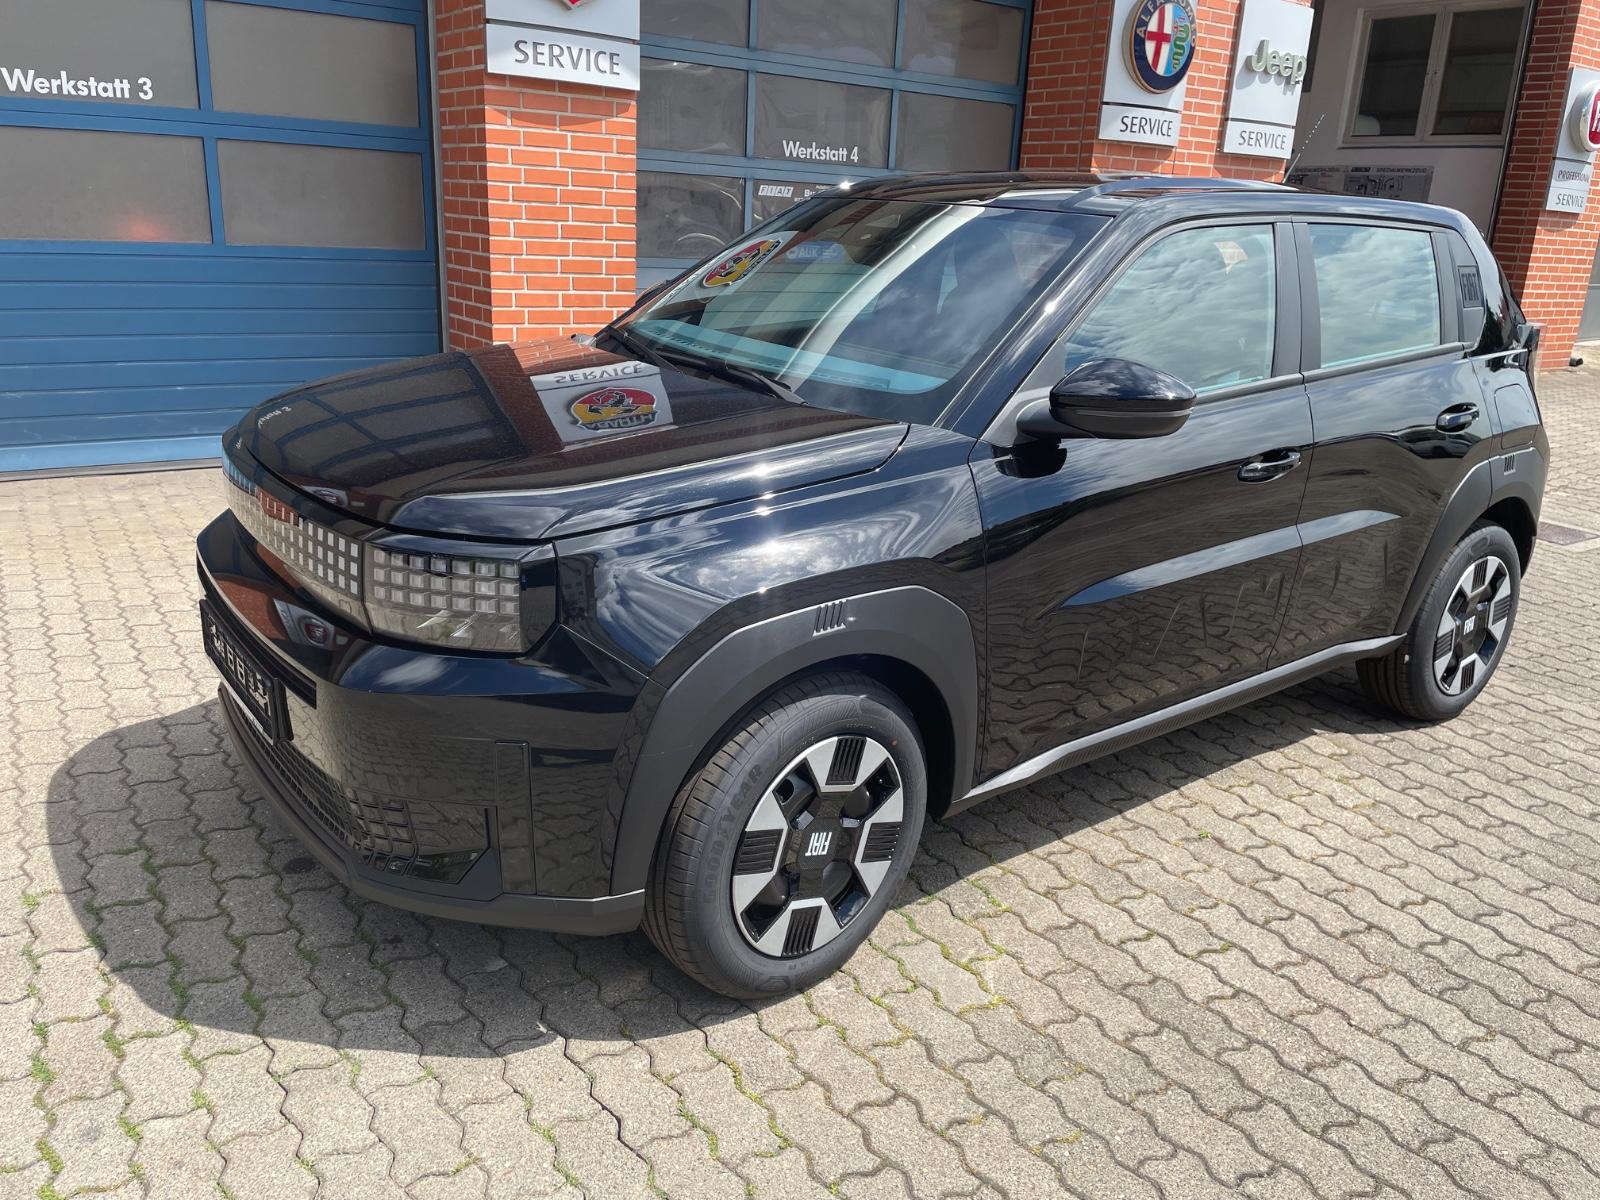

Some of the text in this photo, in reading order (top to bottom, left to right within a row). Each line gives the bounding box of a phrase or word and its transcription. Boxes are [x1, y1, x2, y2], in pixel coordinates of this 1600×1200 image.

[514, 39, 620, 76] SERVICE
[1251, 39, 1307, 85] Jeep
[0, 67, 154, 101] Werkstatt 3
[1119, 115, 1173, 138] SERVICE
[782, 139, 859, 163] Werkstatt 4
[1238, 130, 1287, 151] SERVICE
[758, 184, 794, 198] FIAT
[1555, 193, 1585, 208] SERVICE
[804, 831, 833, 857] FIAT
